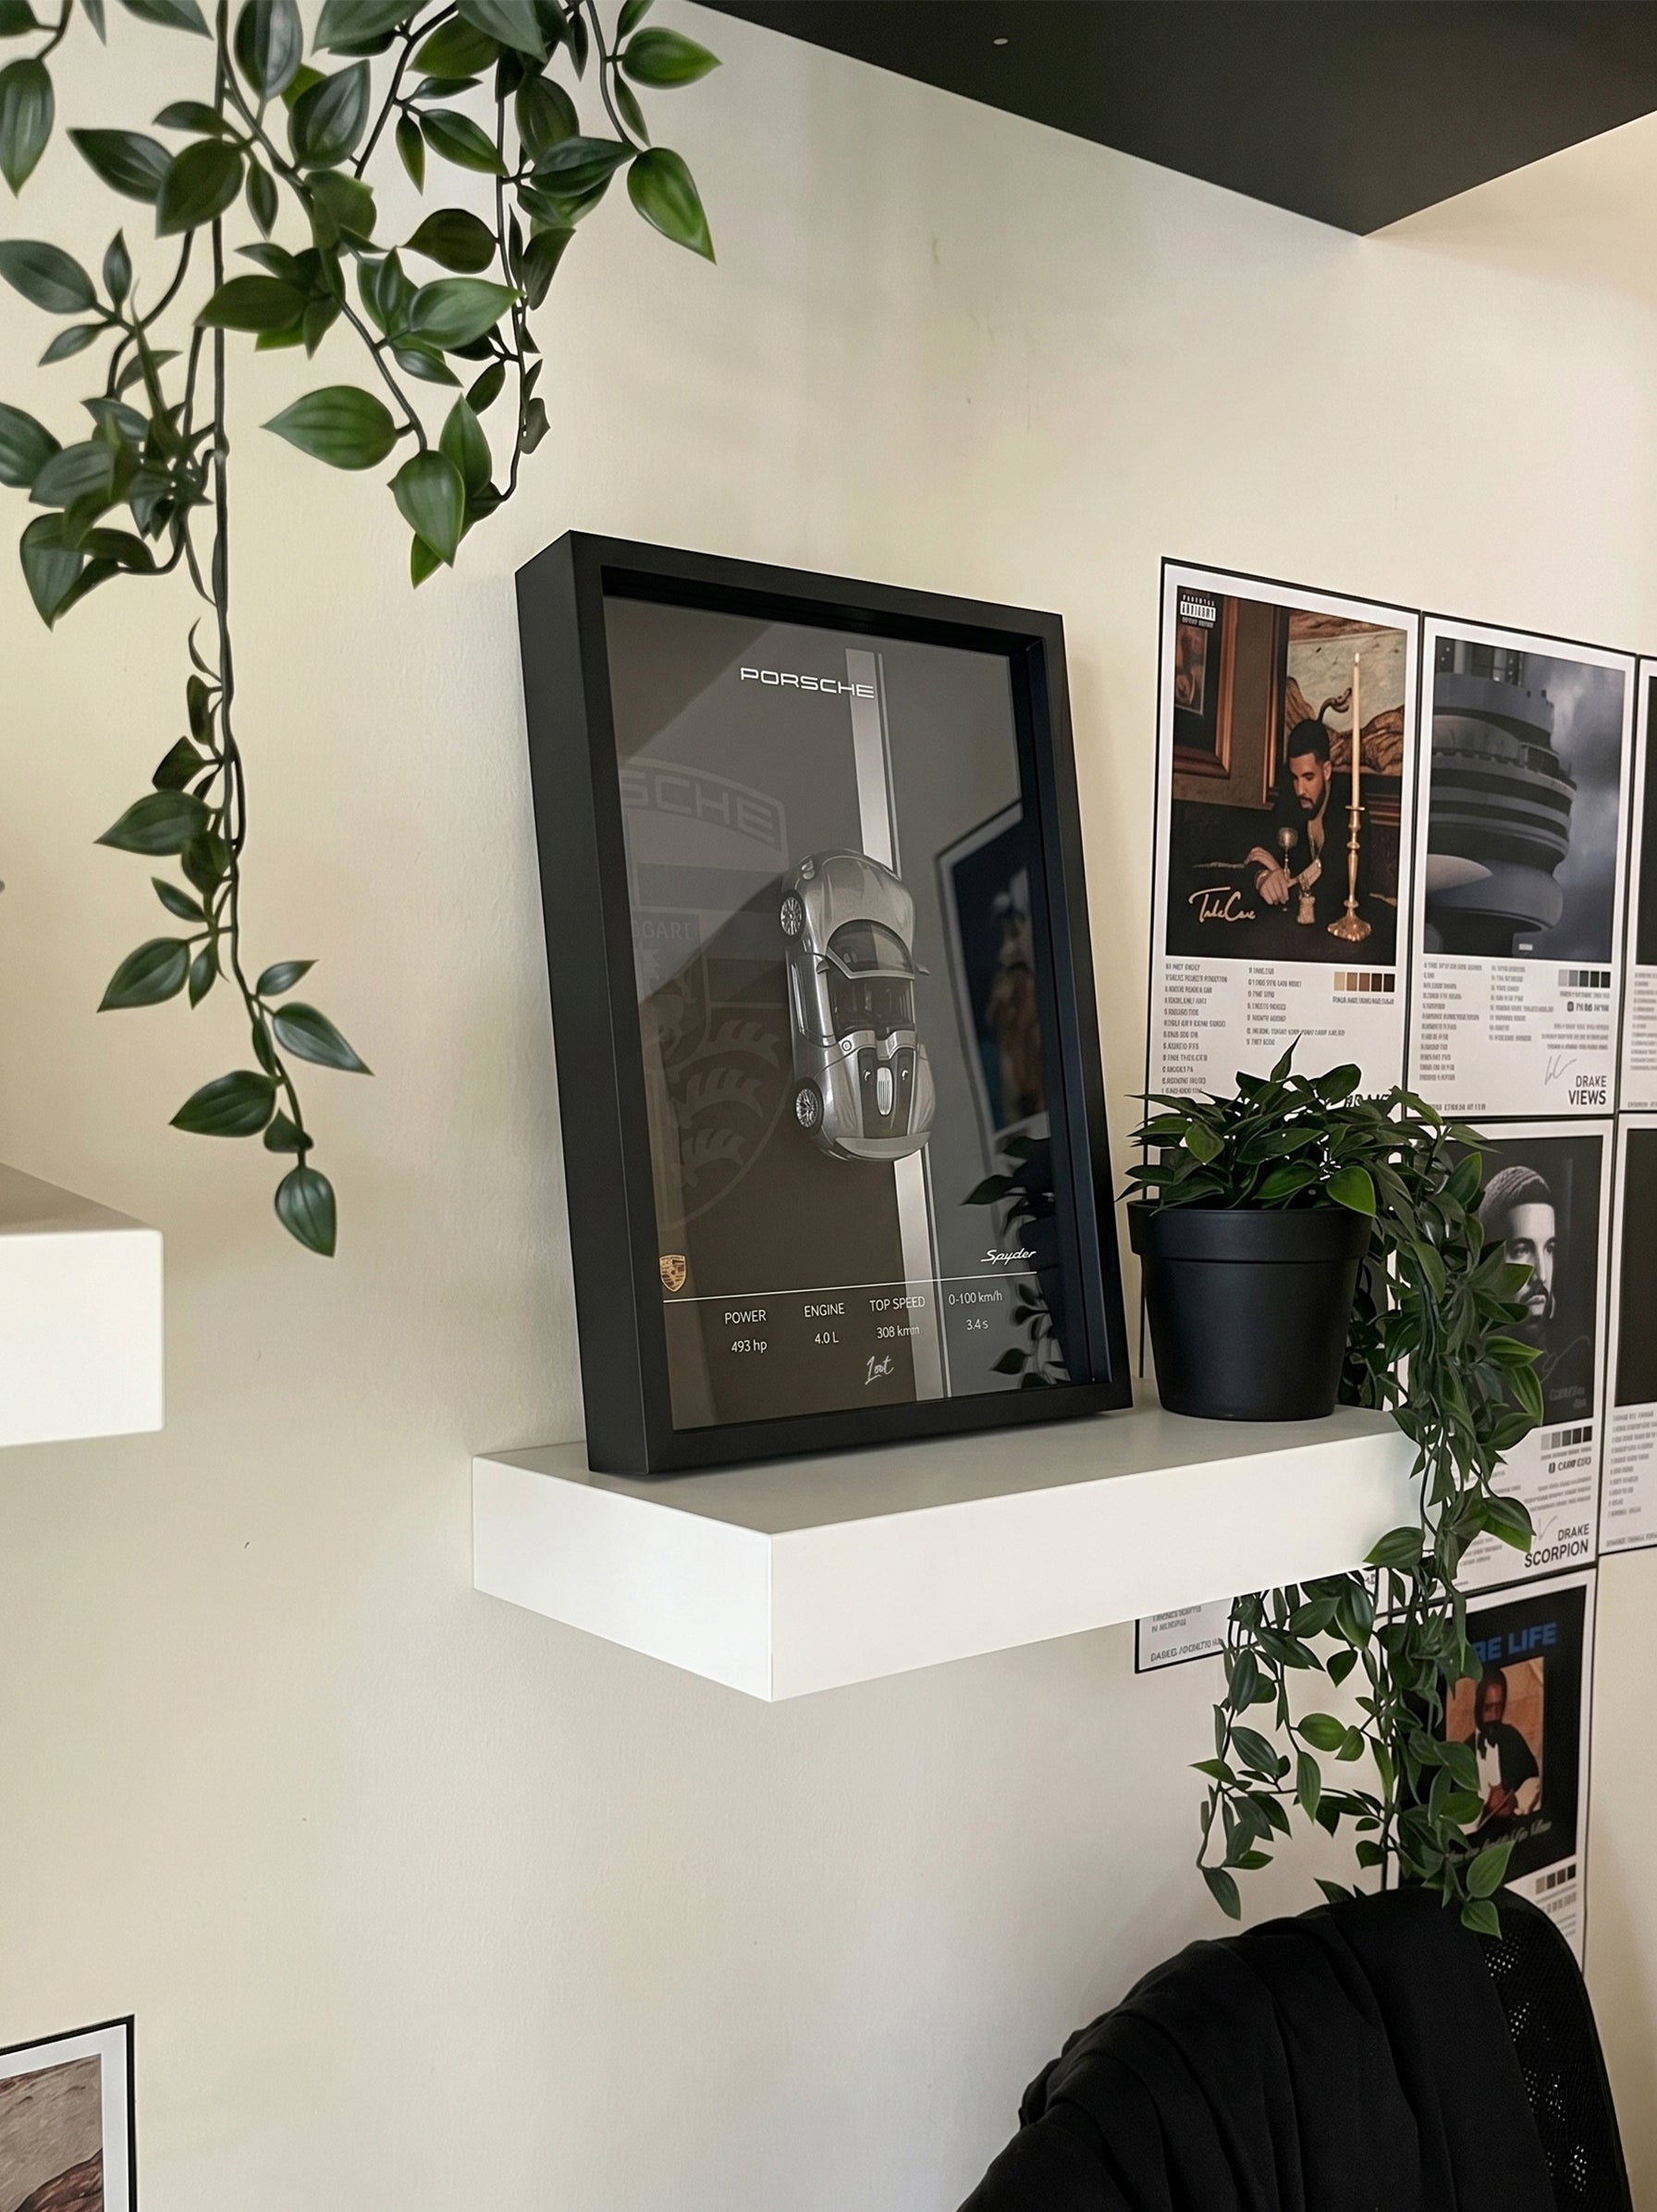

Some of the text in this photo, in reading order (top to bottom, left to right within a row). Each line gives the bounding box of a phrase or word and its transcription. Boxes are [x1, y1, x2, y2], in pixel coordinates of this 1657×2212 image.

[741, 667, 875, 699] PORSCHE
[1576, 1075, 1607, 1088] DRAKE
[1568, 1089, 1607, 1105] VIEWS
[980, 1247, 1037, 1266] Spyder
[869, 1296, 926, 1311] TOP SPEED
[949, 1289, 1003, 1305] 0-100 km/h
[724, 1309, 767, 1324] POWER
[804, 1302, 845, 1318] ENGINE
[877, 1325, 895, 1339] 308
[965, 1318, 988, 1331] 3.4 s
[815, 1332, 840, 1344] 4.0 L
[731, 1339, 767, 1354] 493 hp
[1557, 1523, 1589, 1542] DRAKE
[1524, 1539, 1589, 1568] SCORPION
[1507, 1622, 1558, 1655] LIFE
